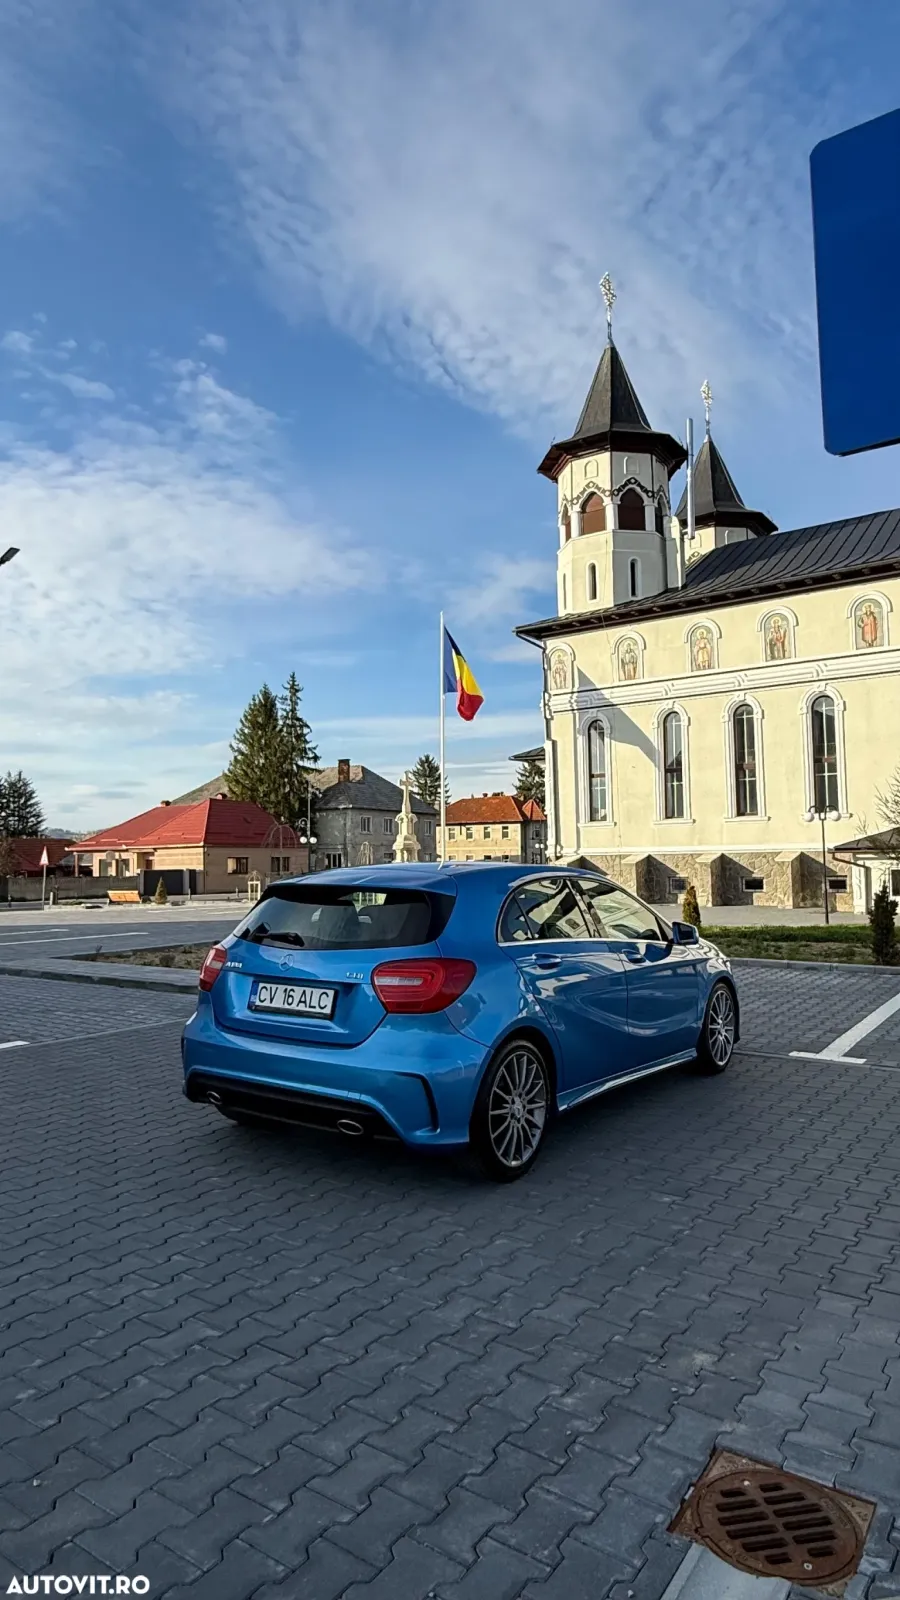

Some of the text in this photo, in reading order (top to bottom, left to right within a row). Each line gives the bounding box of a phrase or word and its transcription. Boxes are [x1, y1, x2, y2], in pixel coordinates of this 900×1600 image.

[258, 985, 330, 1010] CV 16 ALC
